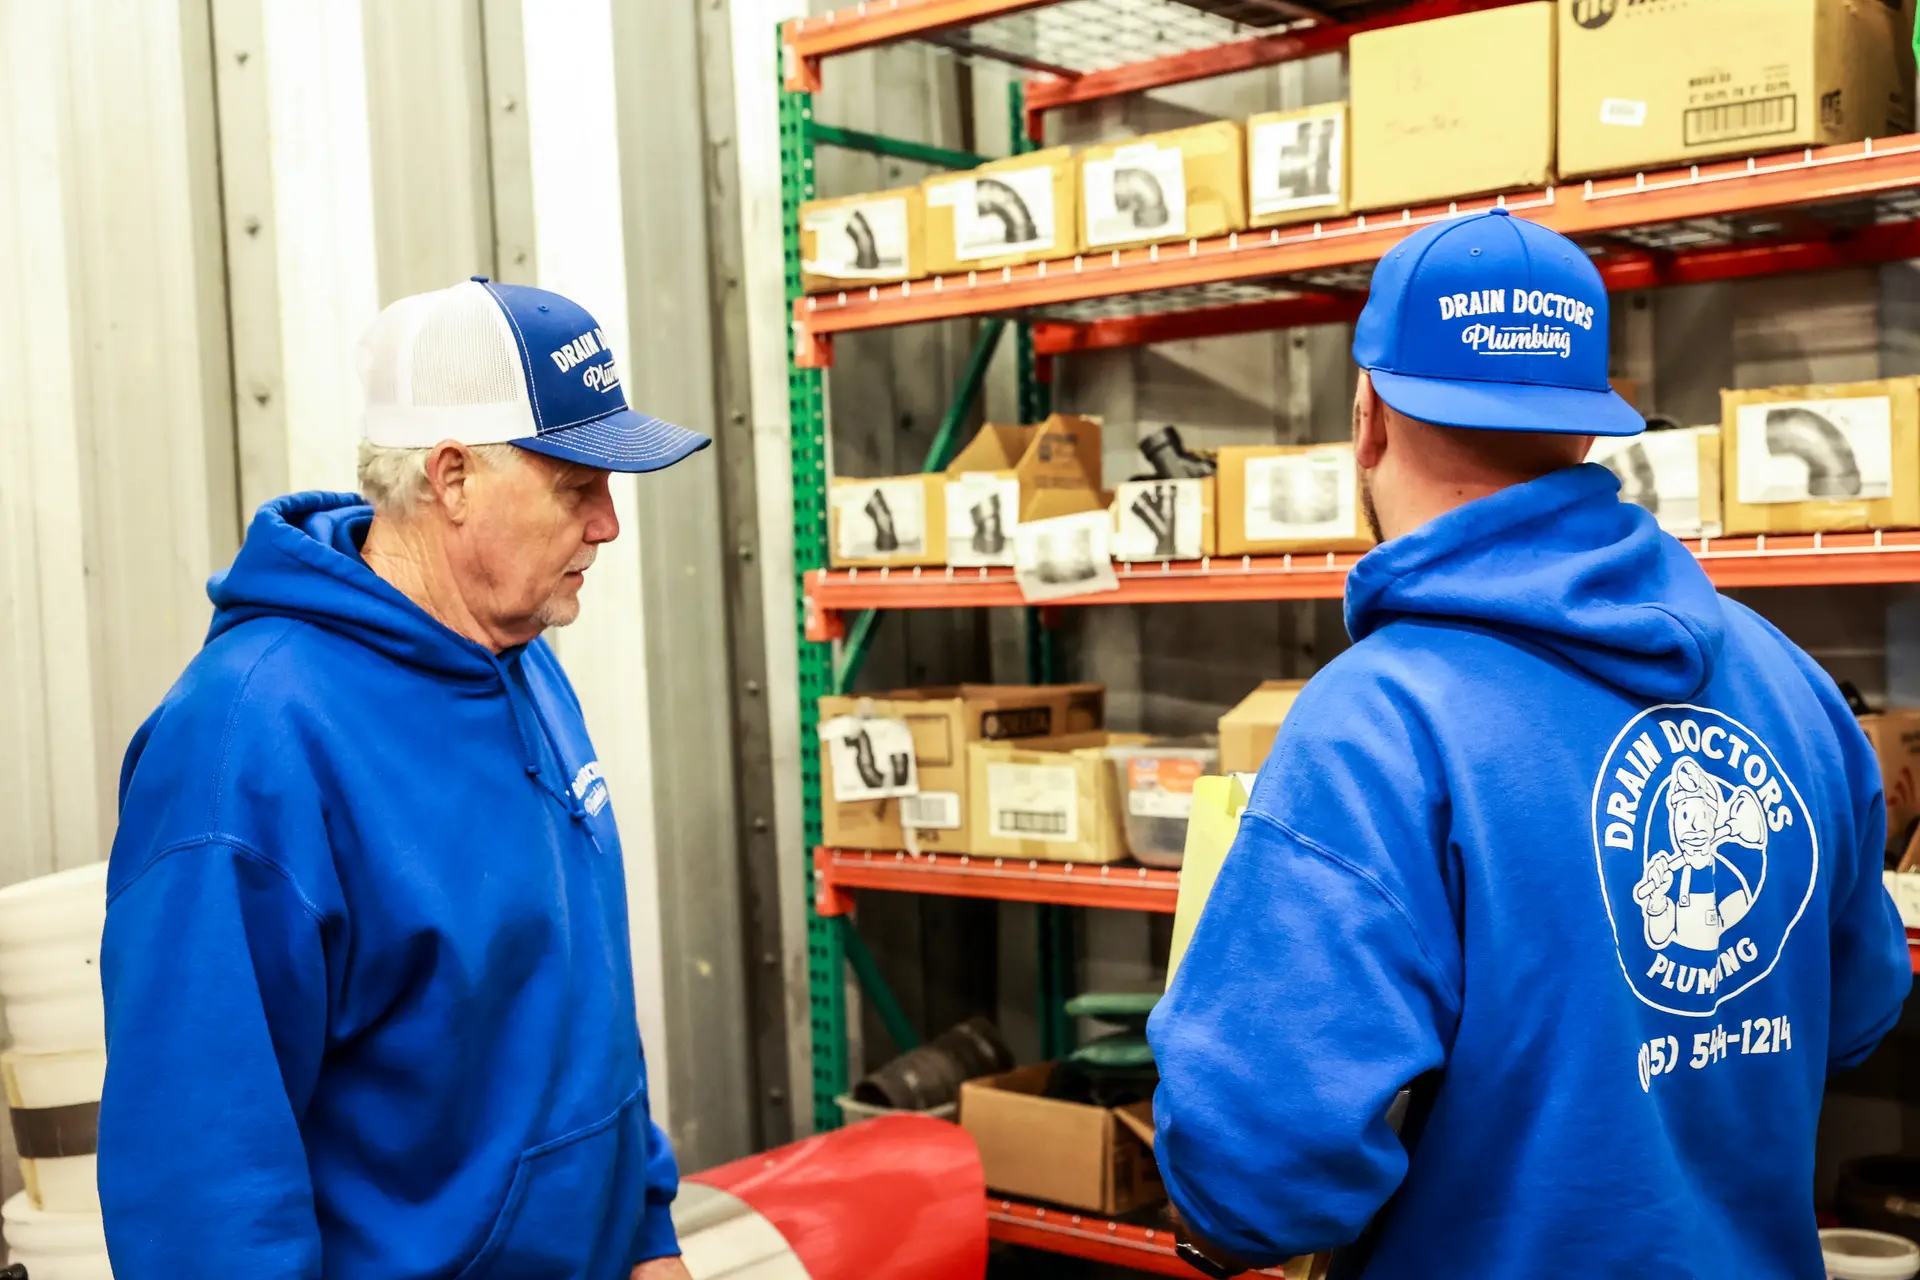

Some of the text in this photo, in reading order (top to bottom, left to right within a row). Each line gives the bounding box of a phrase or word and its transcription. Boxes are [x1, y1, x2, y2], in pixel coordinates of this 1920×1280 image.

[1438, 288, 1594, 330] DRAIN DOCTORS
[550, 331, 601, 374] DRAIN
[1461, 323, 1571, 359] Plumbing
[1604, 719, 1794, 851] DRAIN DOCTORS
[1645, 937, 1759, 995] PLUMING
[1689, 1015, 1792, 1070] 544-1214
